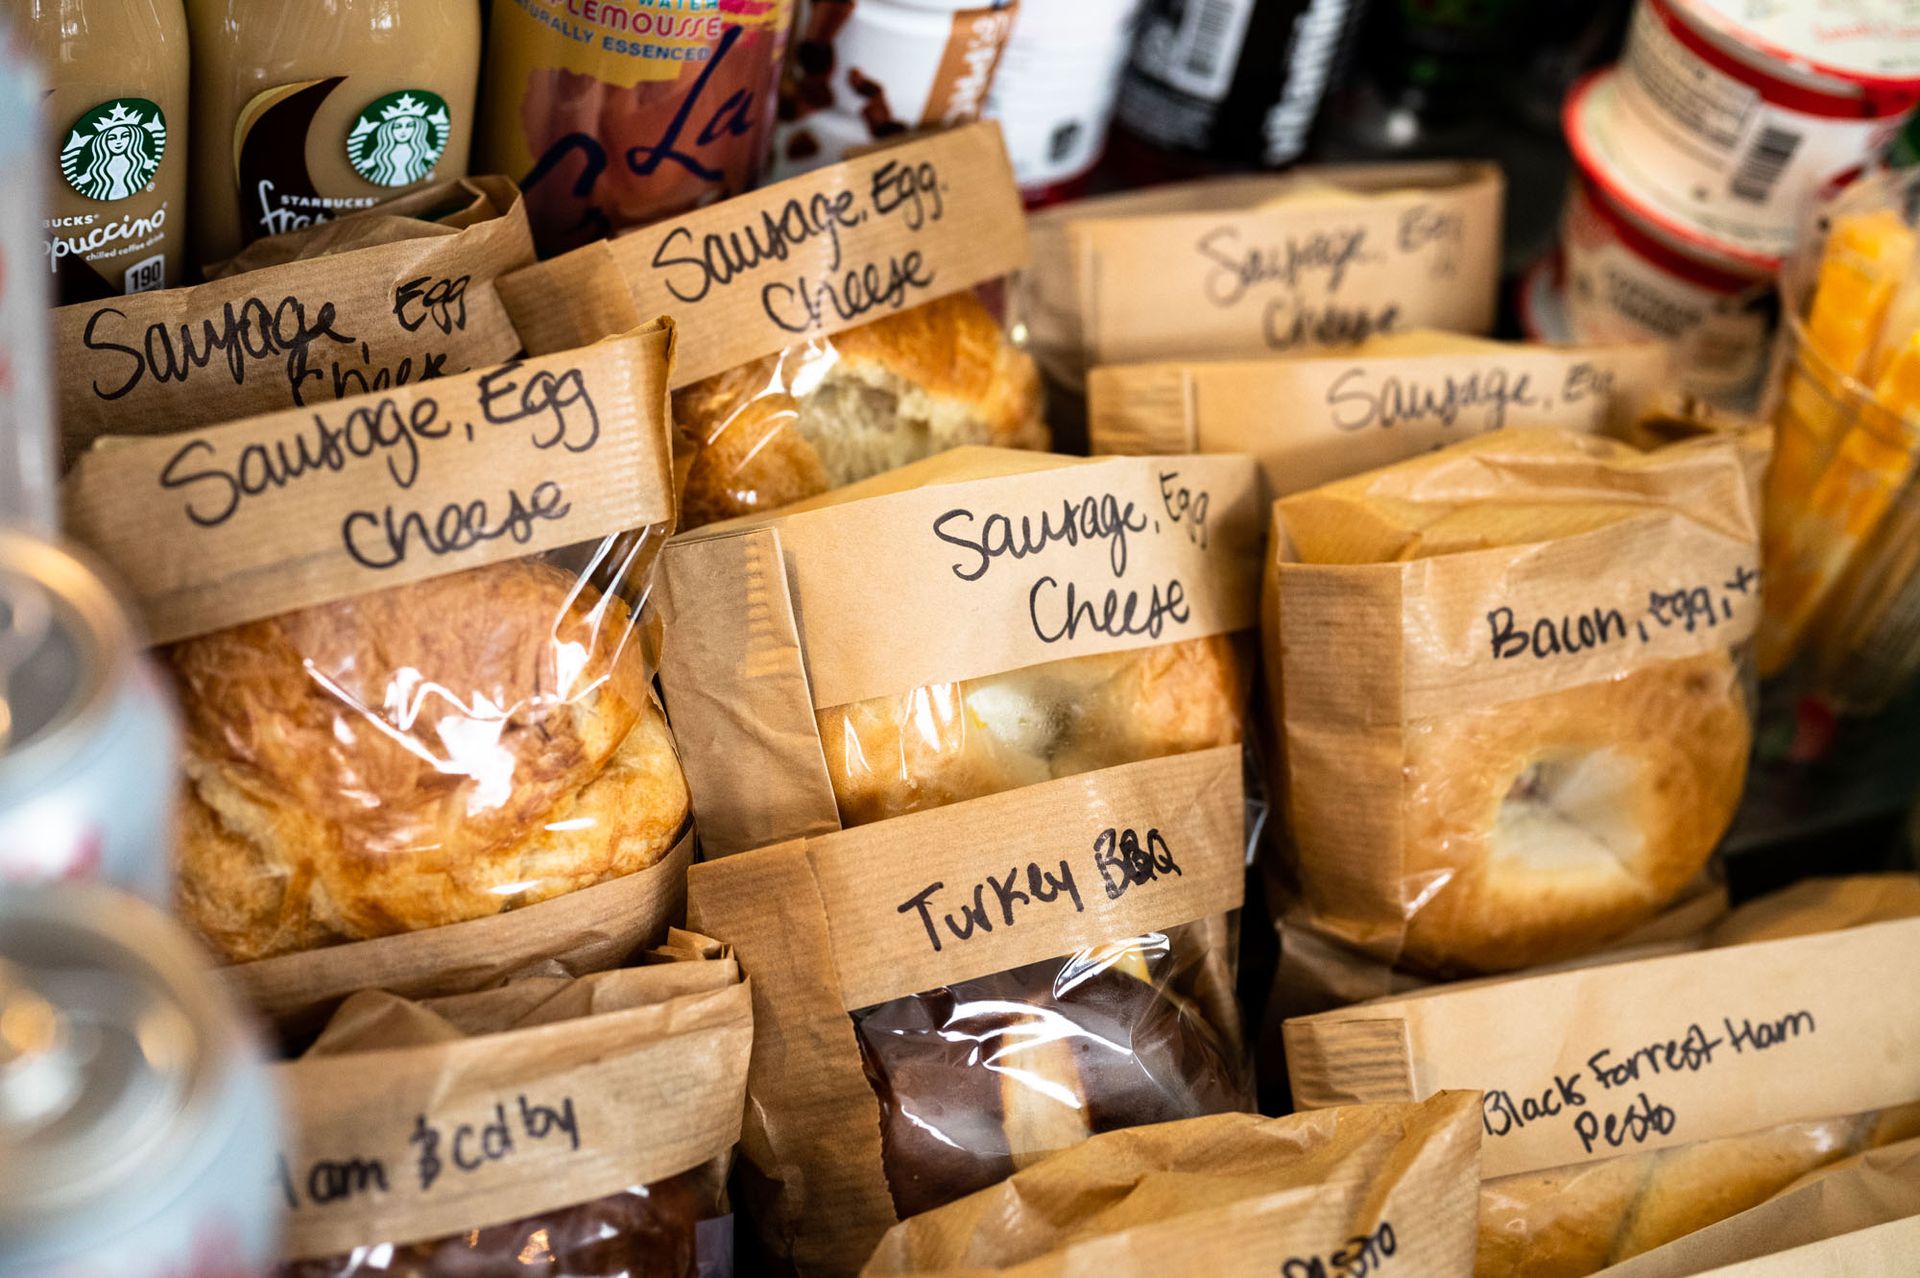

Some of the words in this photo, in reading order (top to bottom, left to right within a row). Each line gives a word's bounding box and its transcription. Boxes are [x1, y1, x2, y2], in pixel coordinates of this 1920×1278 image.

[566, 0, 721, 37] LEMOUSSE
[602, 36, 711, 61] ESSENCED
[42, 214, 94, 229] BUCKS
[281, 195, 374, 208] STARBUCKS
[43, 209, 165, 273] puccino
[86, 248, 117, 261] chilled
[118, 242, 145, 256] coffee
[131, 261, 161, 290] 190
[477, 360, 600, 453] Egg
[1029, 575, 1190, 644] Cheese
[896, 859, 1085, 952] Turkey
[1092, 827, 1183, 900] BBQ
[1482, 1073, 1587, 1136] Black
[1723, 1010, 1816, 1053] Ham
[1573, 1092, 1677, 1154] Pesto
